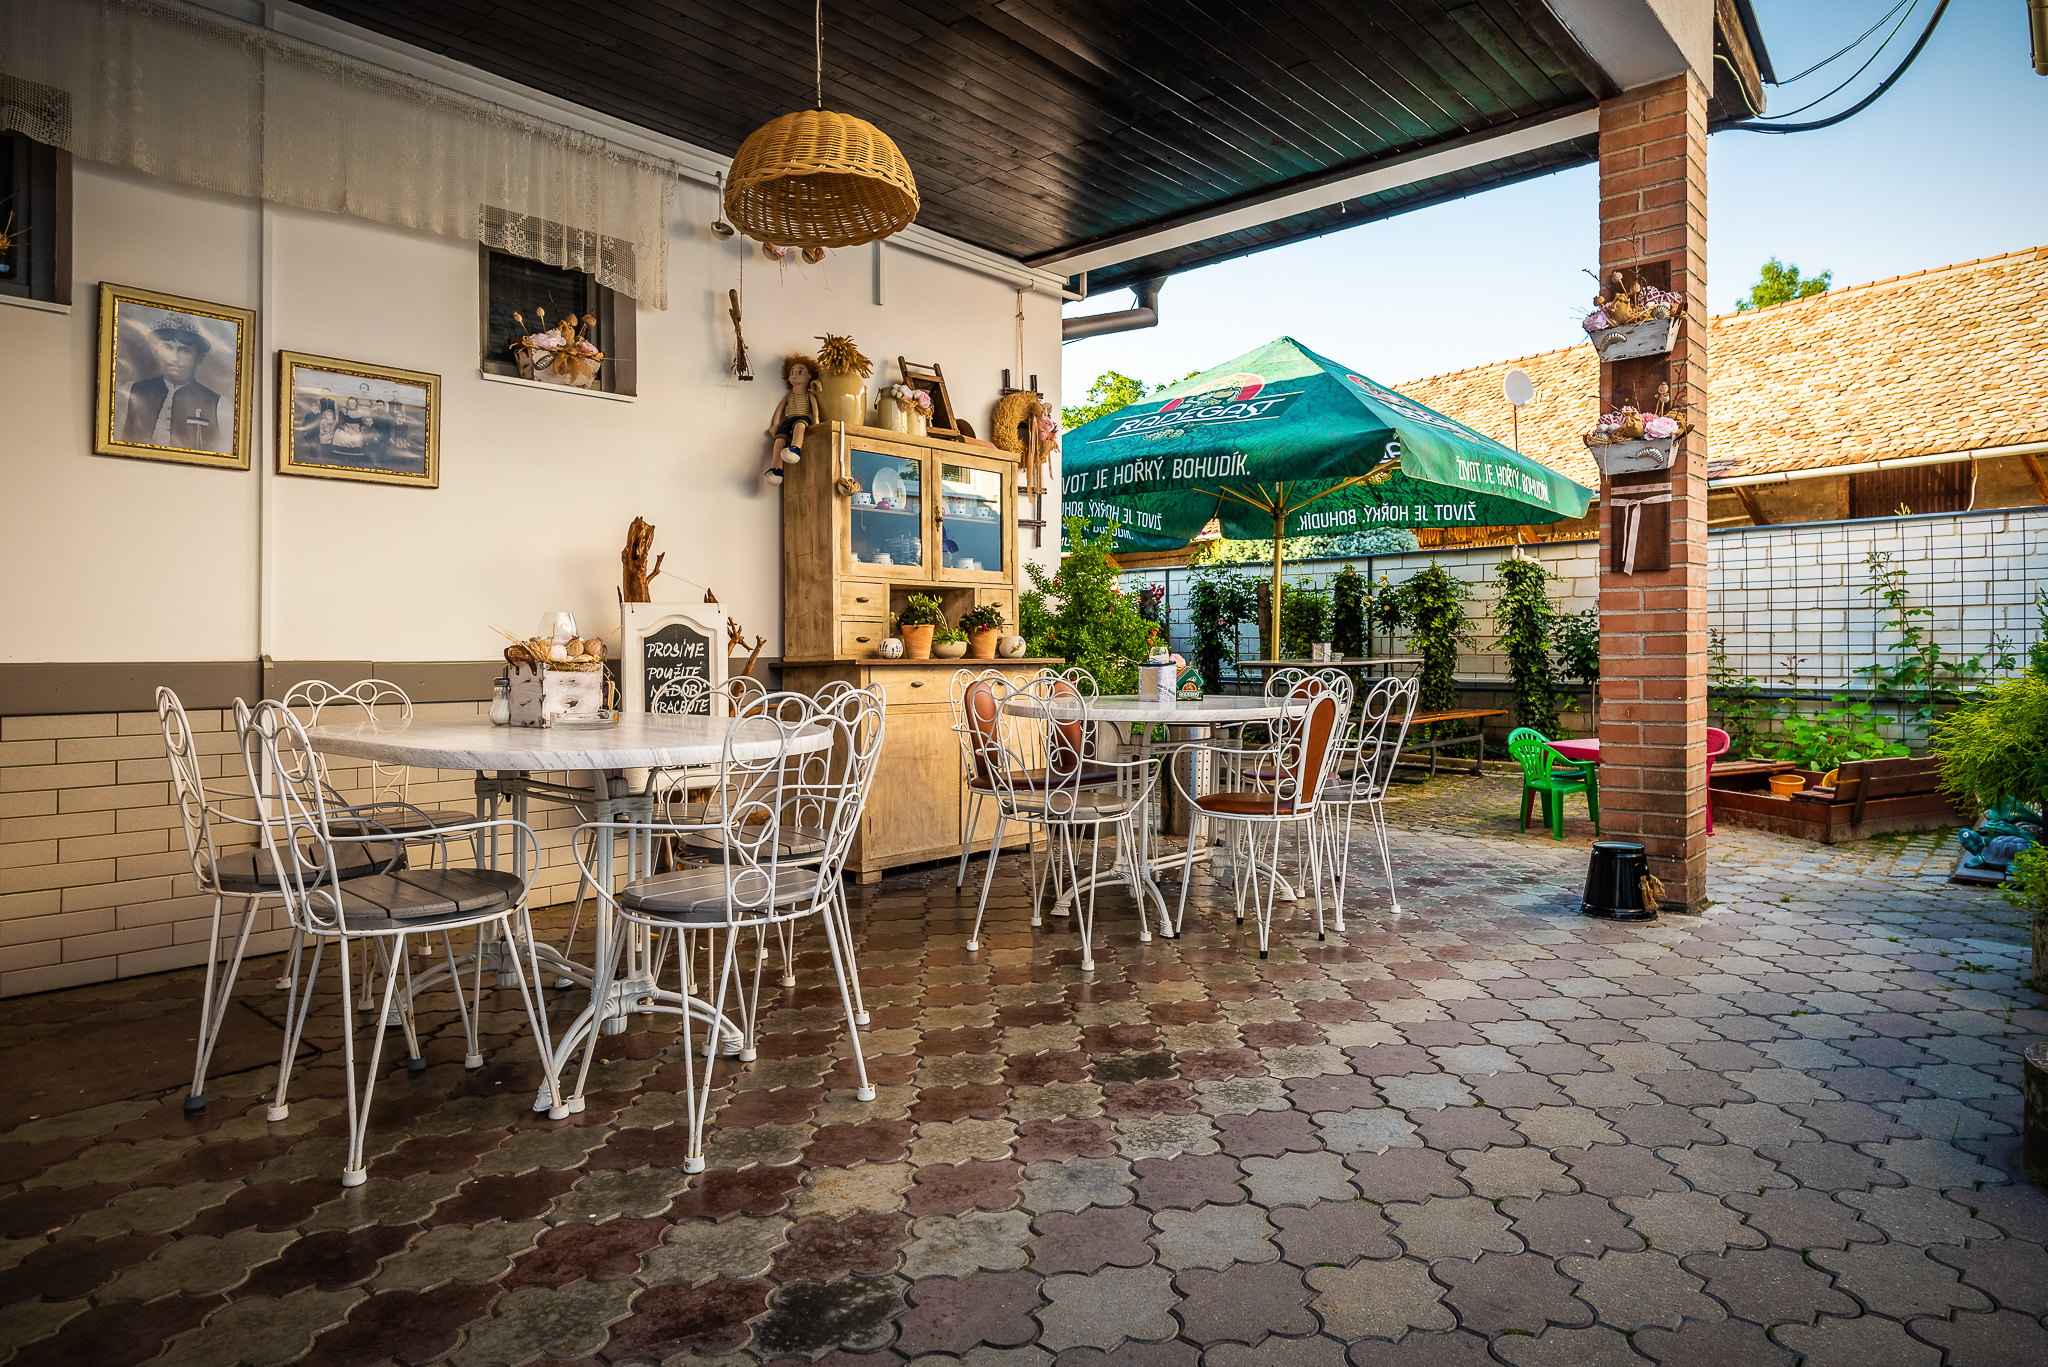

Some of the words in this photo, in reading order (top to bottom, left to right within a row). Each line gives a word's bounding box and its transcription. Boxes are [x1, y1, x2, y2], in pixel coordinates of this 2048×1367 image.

[1108, 398, 1286, 437] RADEGAST
[1061, 472, 1089, 495] VOT
[1093, 469, 1108, 490] JE
[1113, 456, 1166, 486] HOŘKÝ.
[1172, 451, 1251, 479] BOHUDÍK.
[1455, 455, 1481, 483] ŽIVOT
[1484, 463, 1495, 484] JE
[646, 638, 705, 659] PROSÍME
